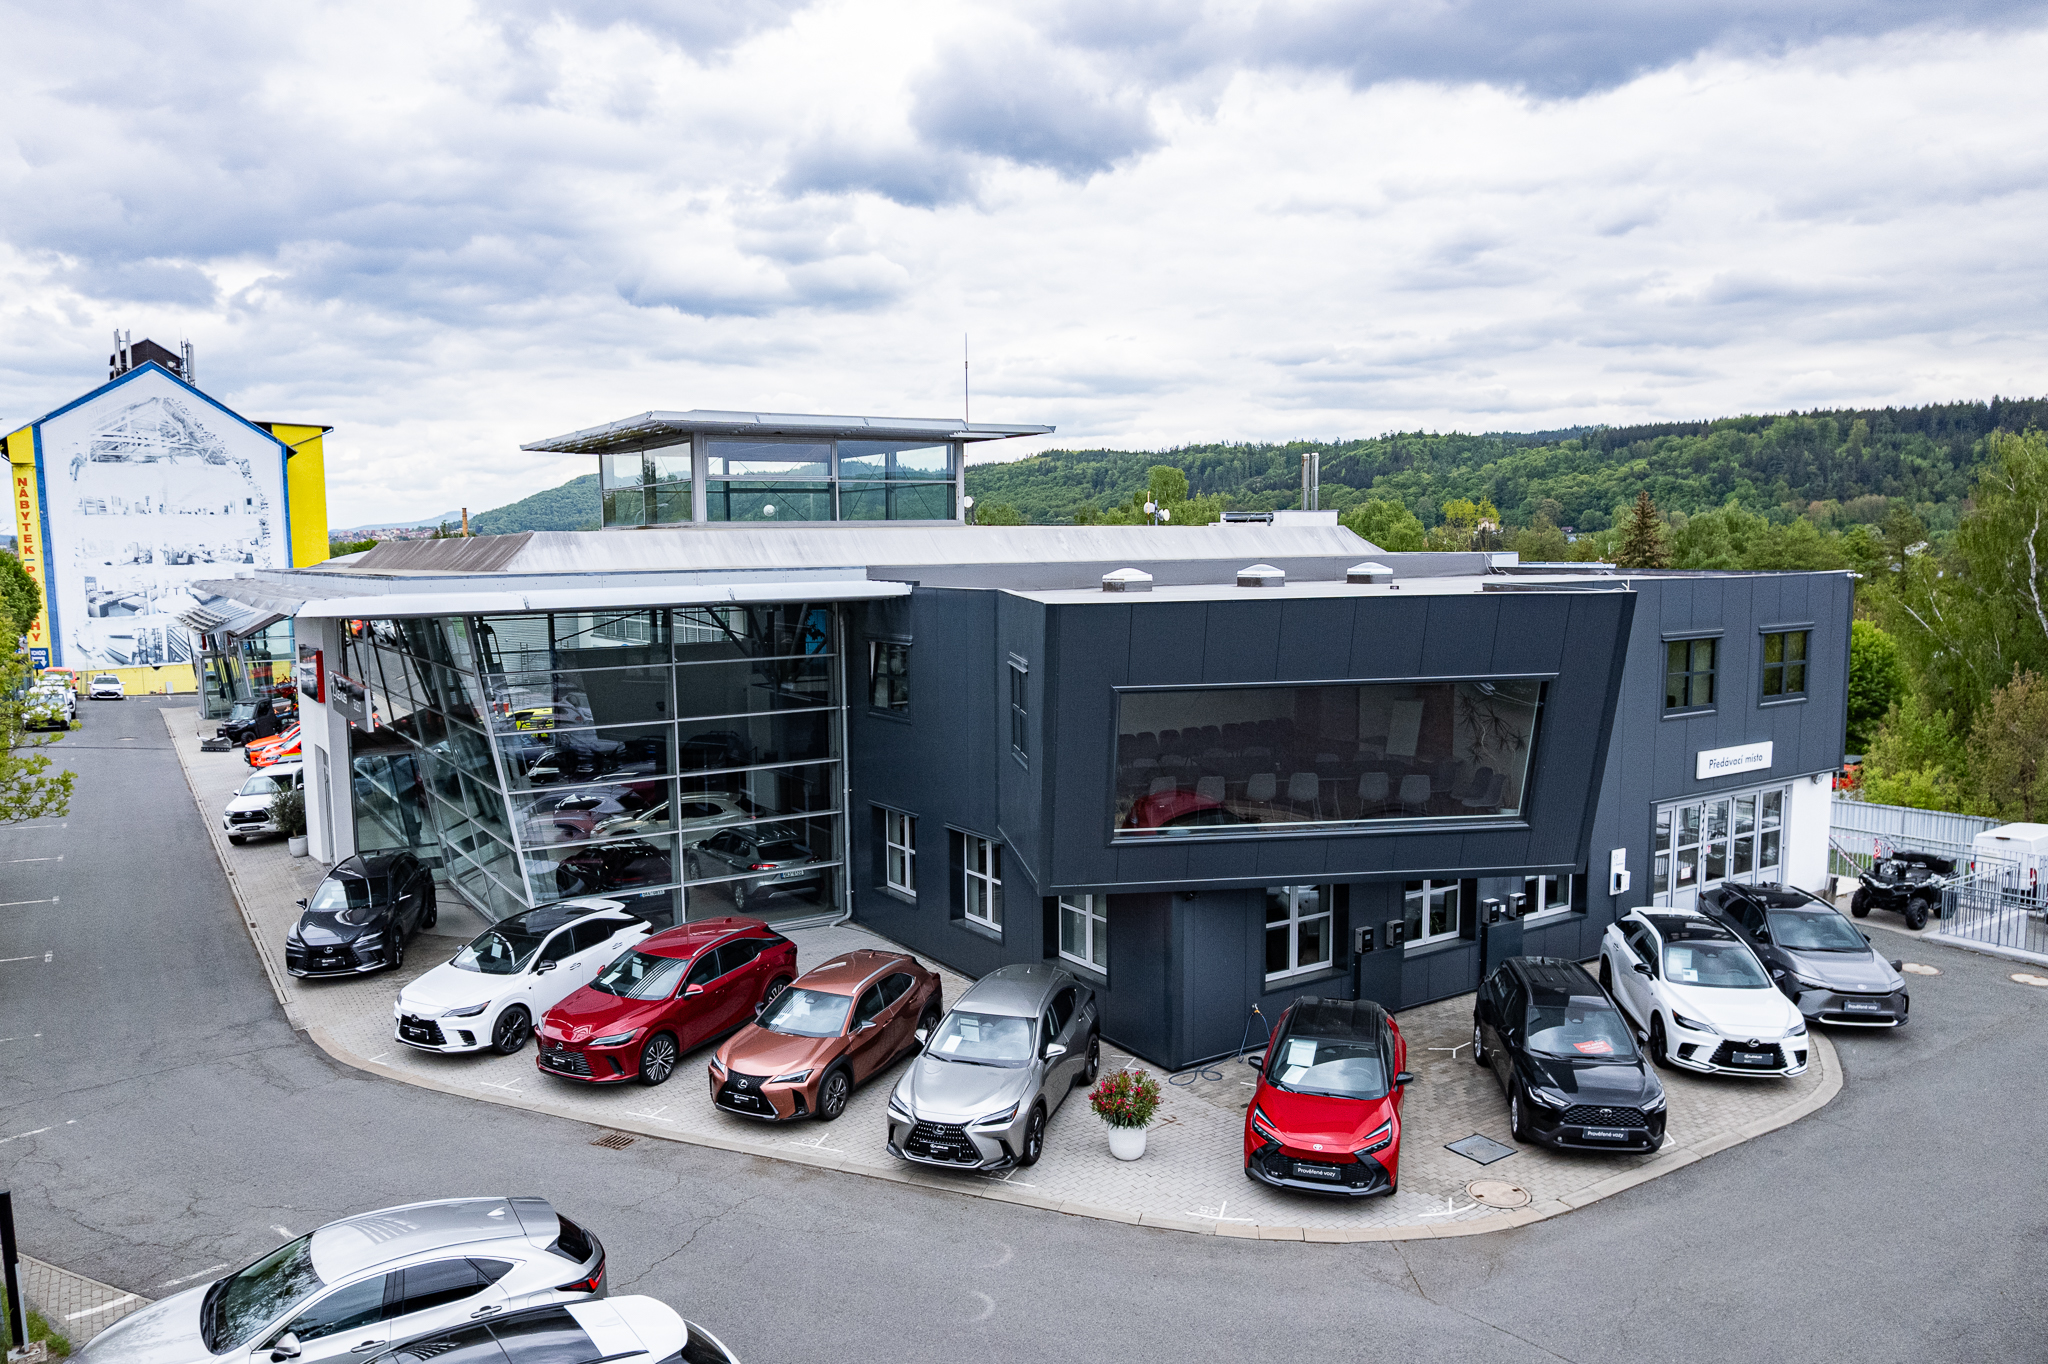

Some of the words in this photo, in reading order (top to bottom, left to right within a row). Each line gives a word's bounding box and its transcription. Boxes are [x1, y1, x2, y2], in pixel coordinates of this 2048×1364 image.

[17, 477, 34, 554] NÁBYTEK
[1708, 755, 1743, 769] Předávací
[1744, 753, 1763, 764] místo
